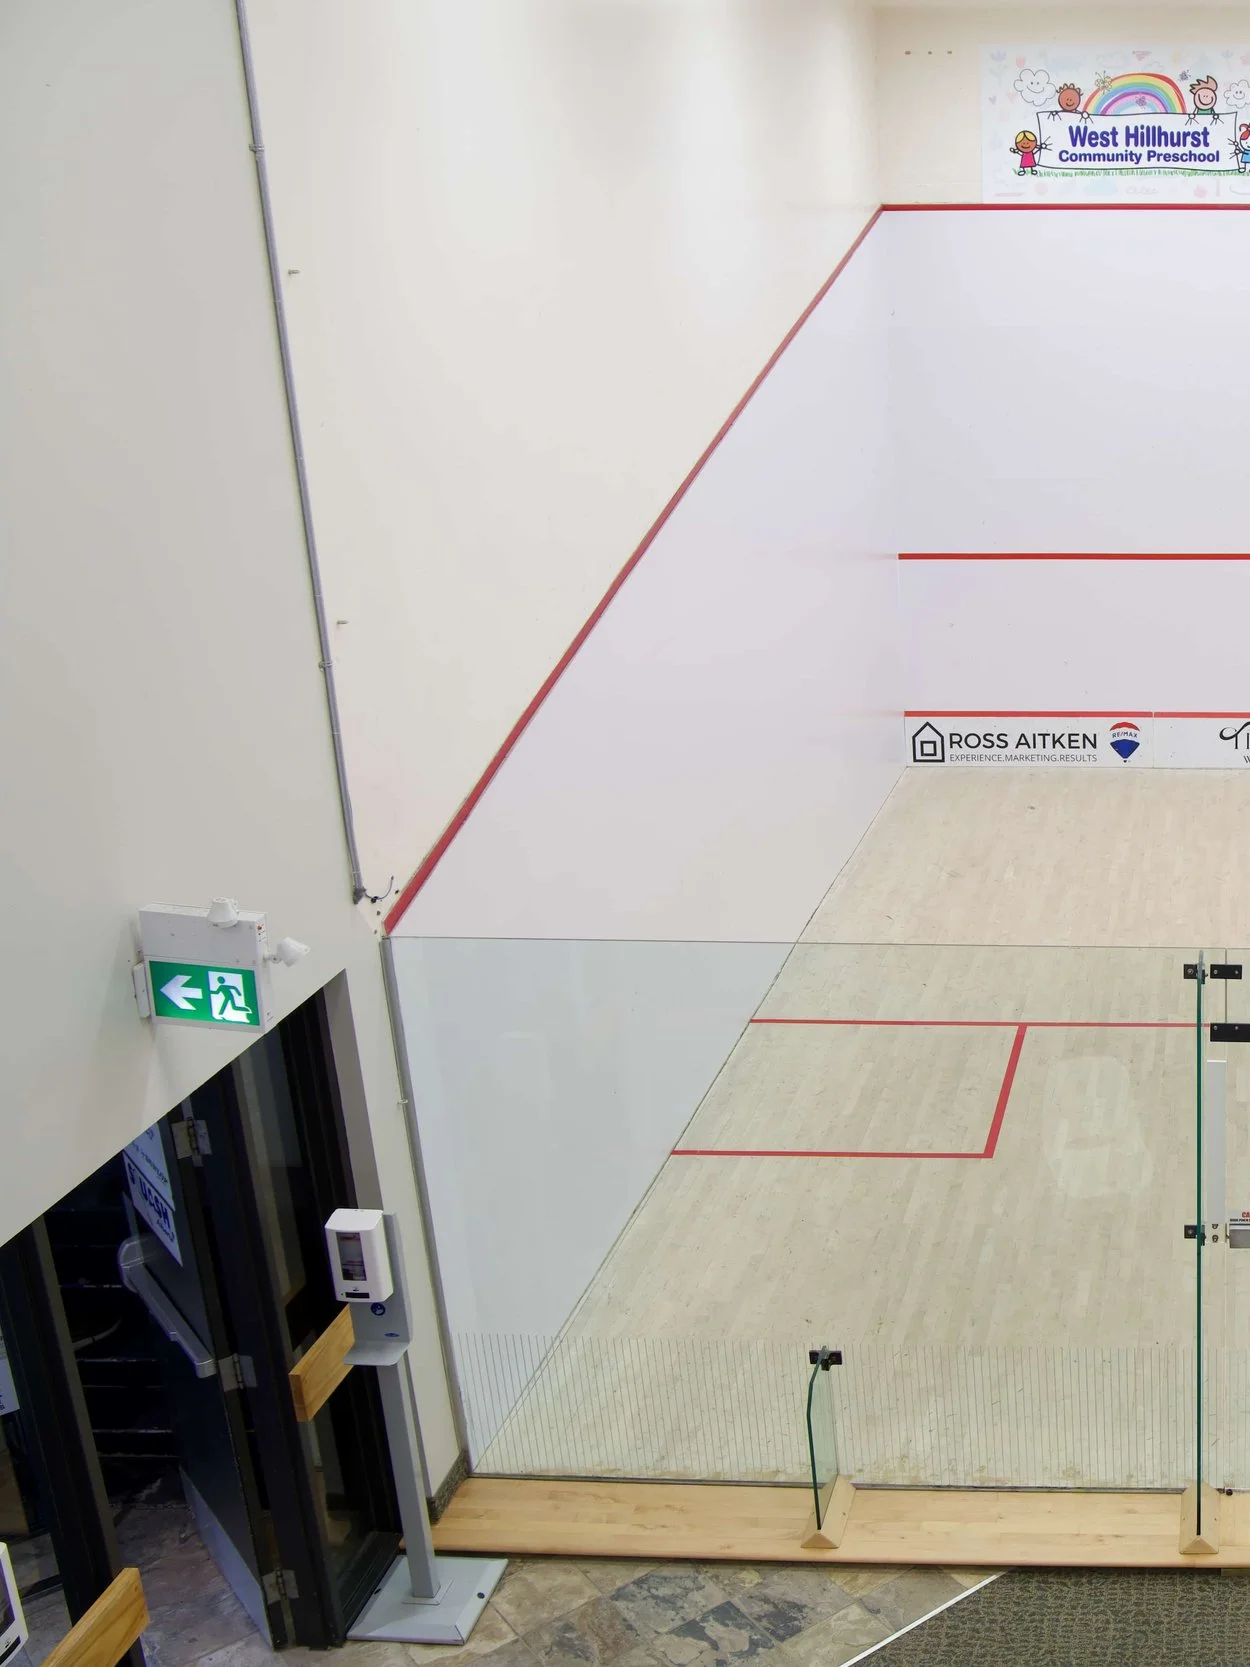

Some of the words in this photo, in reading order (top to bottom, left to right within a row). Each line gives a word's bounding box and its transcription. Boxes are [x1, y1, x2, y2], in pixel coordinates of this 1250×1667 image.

[1068, 125, 1118, 147] West
[1125, 125, 1210, 147] Hillhurst
[1058, 150, 1142, 164] Community
[1147, 150, 1219, 163] Preschool
[949, 733, 1008, 749] ROSS
[1015, 733, 1097, 749] AITKEN
[950, 754, 1097, 763] EXPERIENCE.MARKETING.RESULTS
